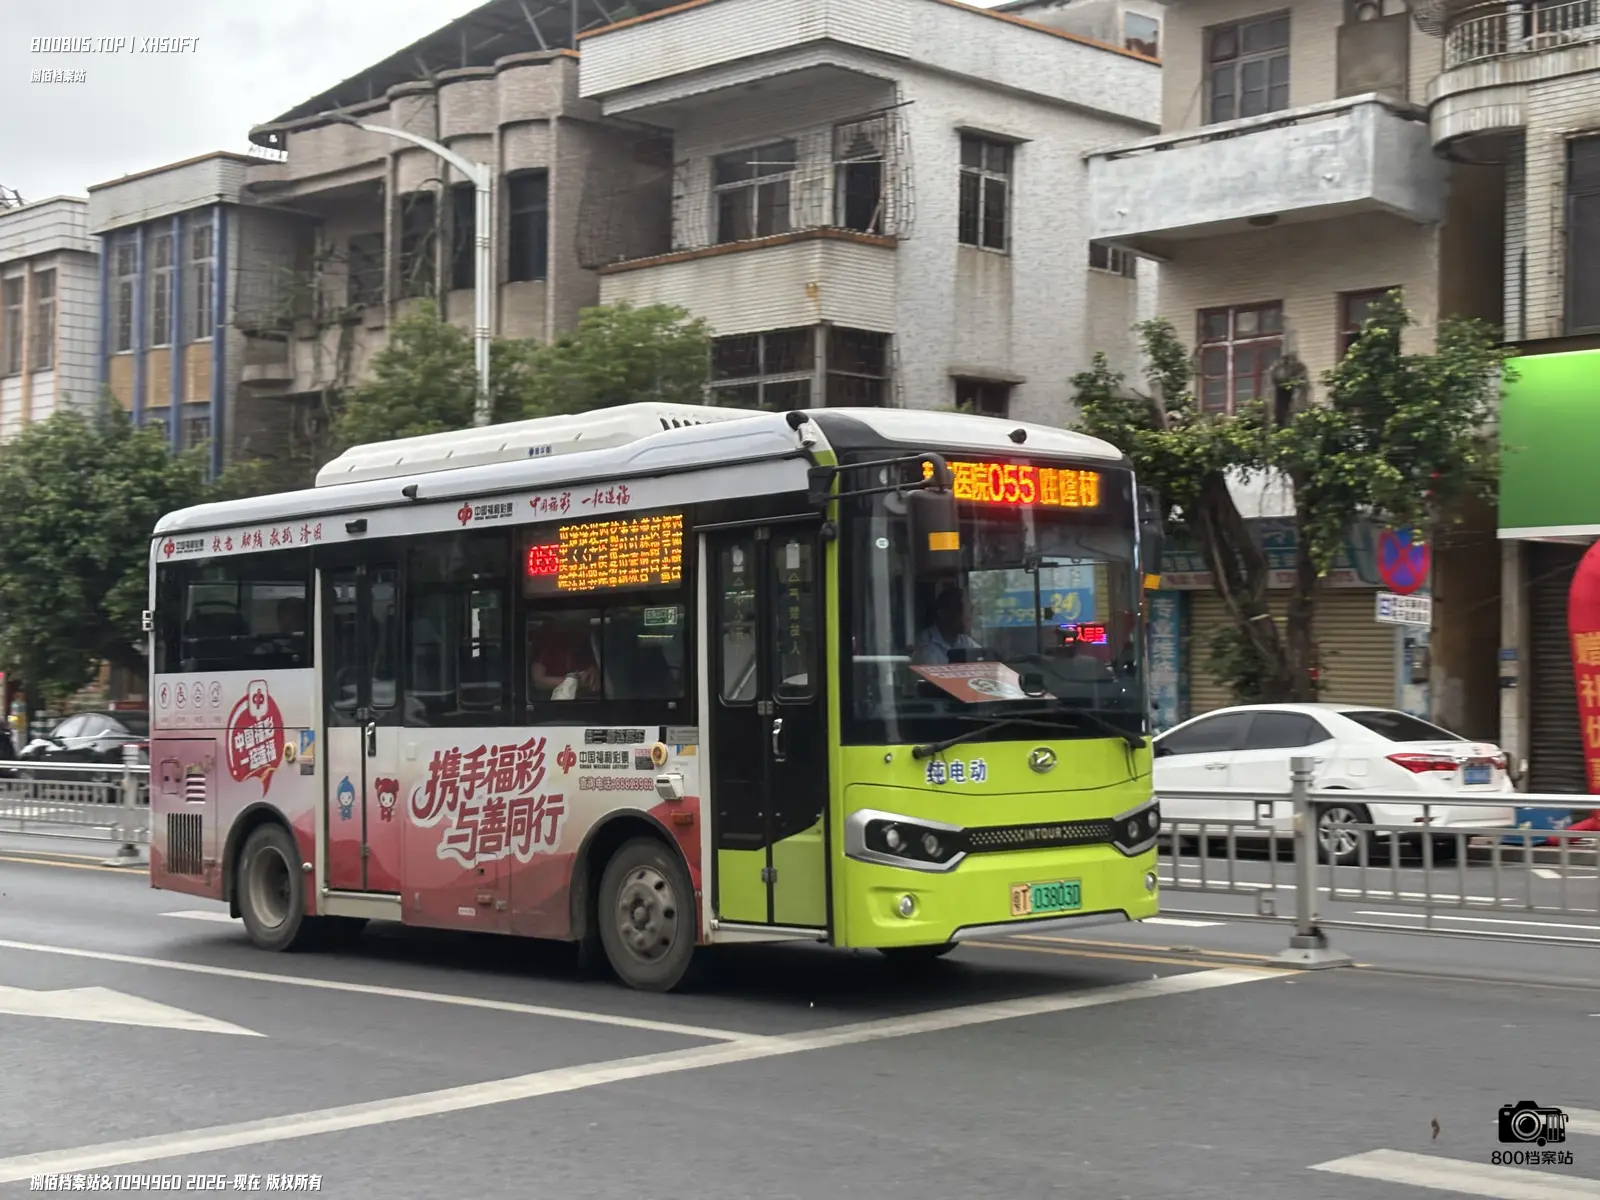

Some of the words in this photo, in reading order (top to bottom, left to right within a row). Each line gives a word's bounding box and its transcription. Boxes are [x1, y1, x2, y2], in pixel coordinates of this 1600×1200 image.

[989, 463, 1036, 503] 055
[412, 736, 547, 821] 携手福彩
[926, 759, 988, 785] 纯电动
[441, 794, 564, 859] 与善同行
